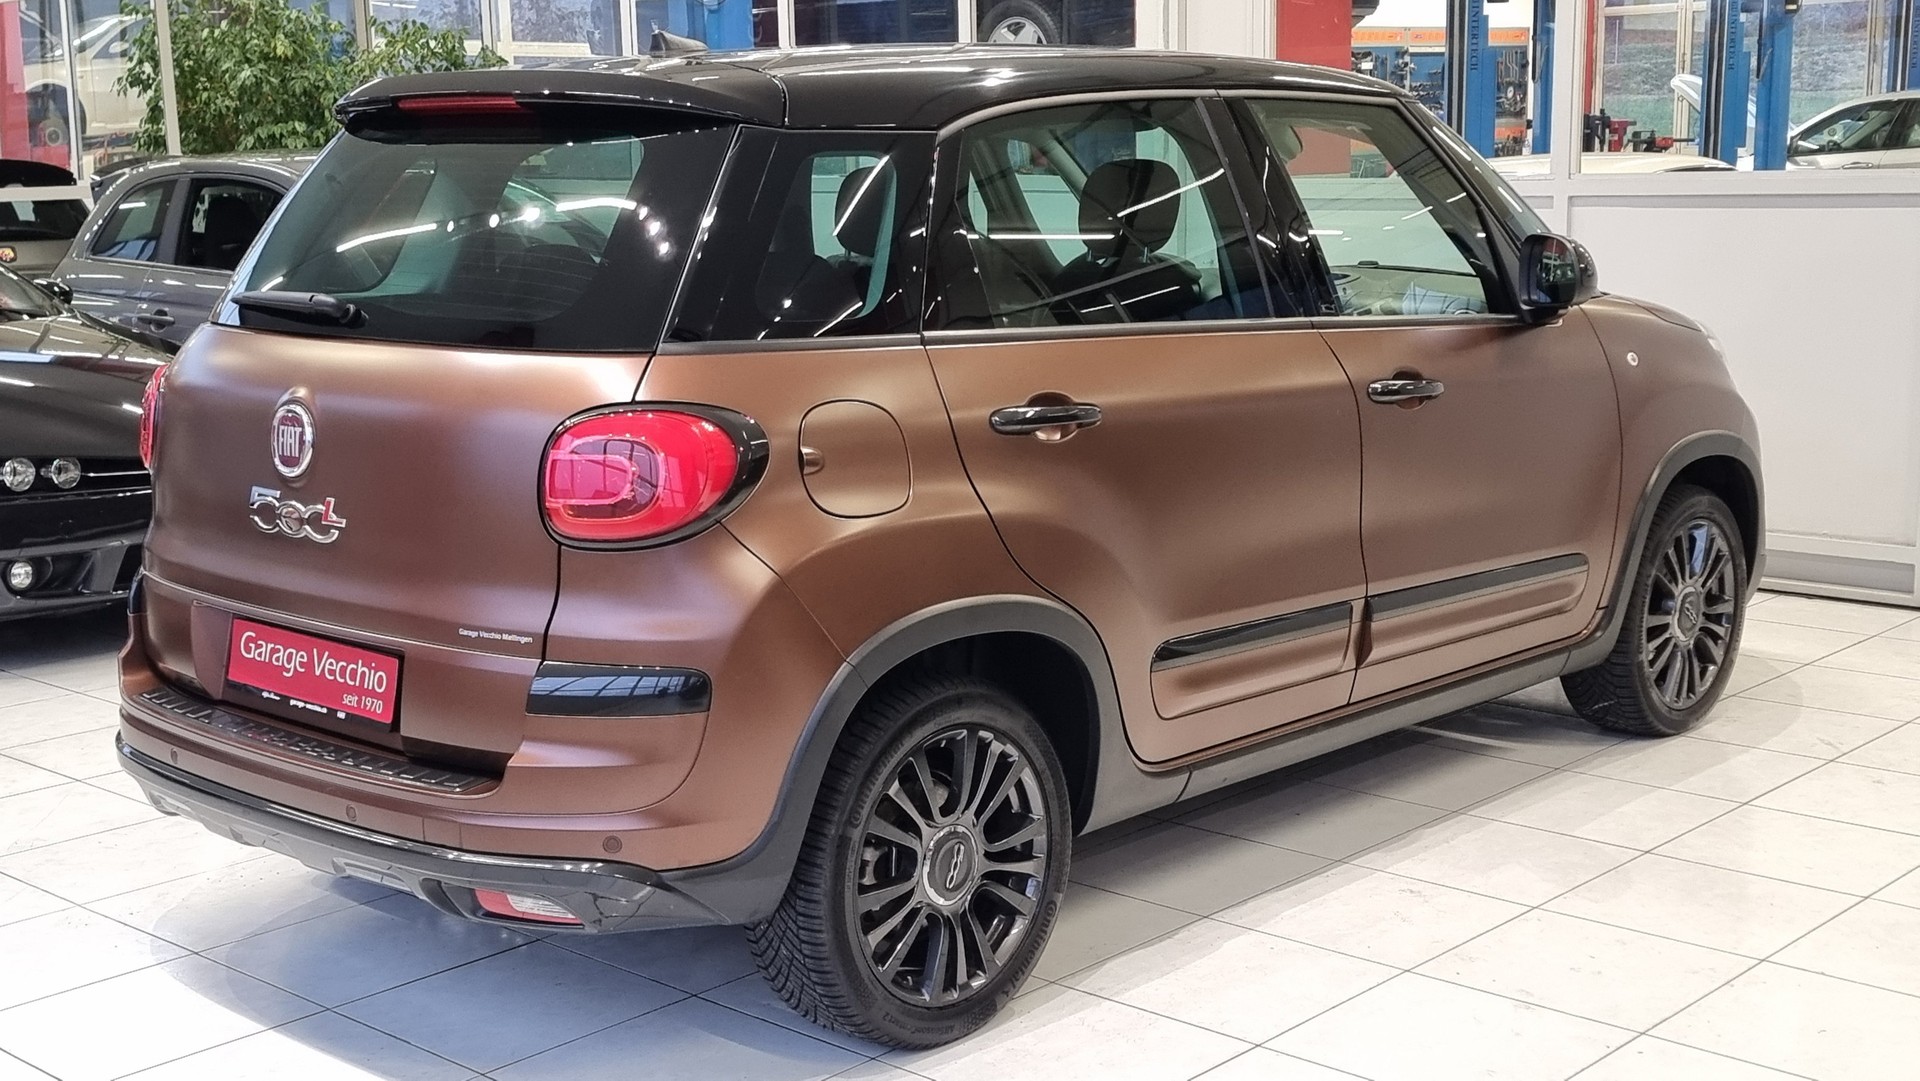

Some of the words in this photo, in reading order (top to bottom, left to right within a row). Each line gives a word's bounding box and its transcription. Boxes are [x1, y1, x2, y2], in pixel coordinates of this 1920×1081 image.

[278, 425, 302, 458] FIAT
[240, 631, 308, 677] Garage
[313, 648, 388, 694] Vecchio
[342, 693, 359, 708] seit
[361, 696, 384, 715] 1970
[1009, 900, 1059, 990] Continental
